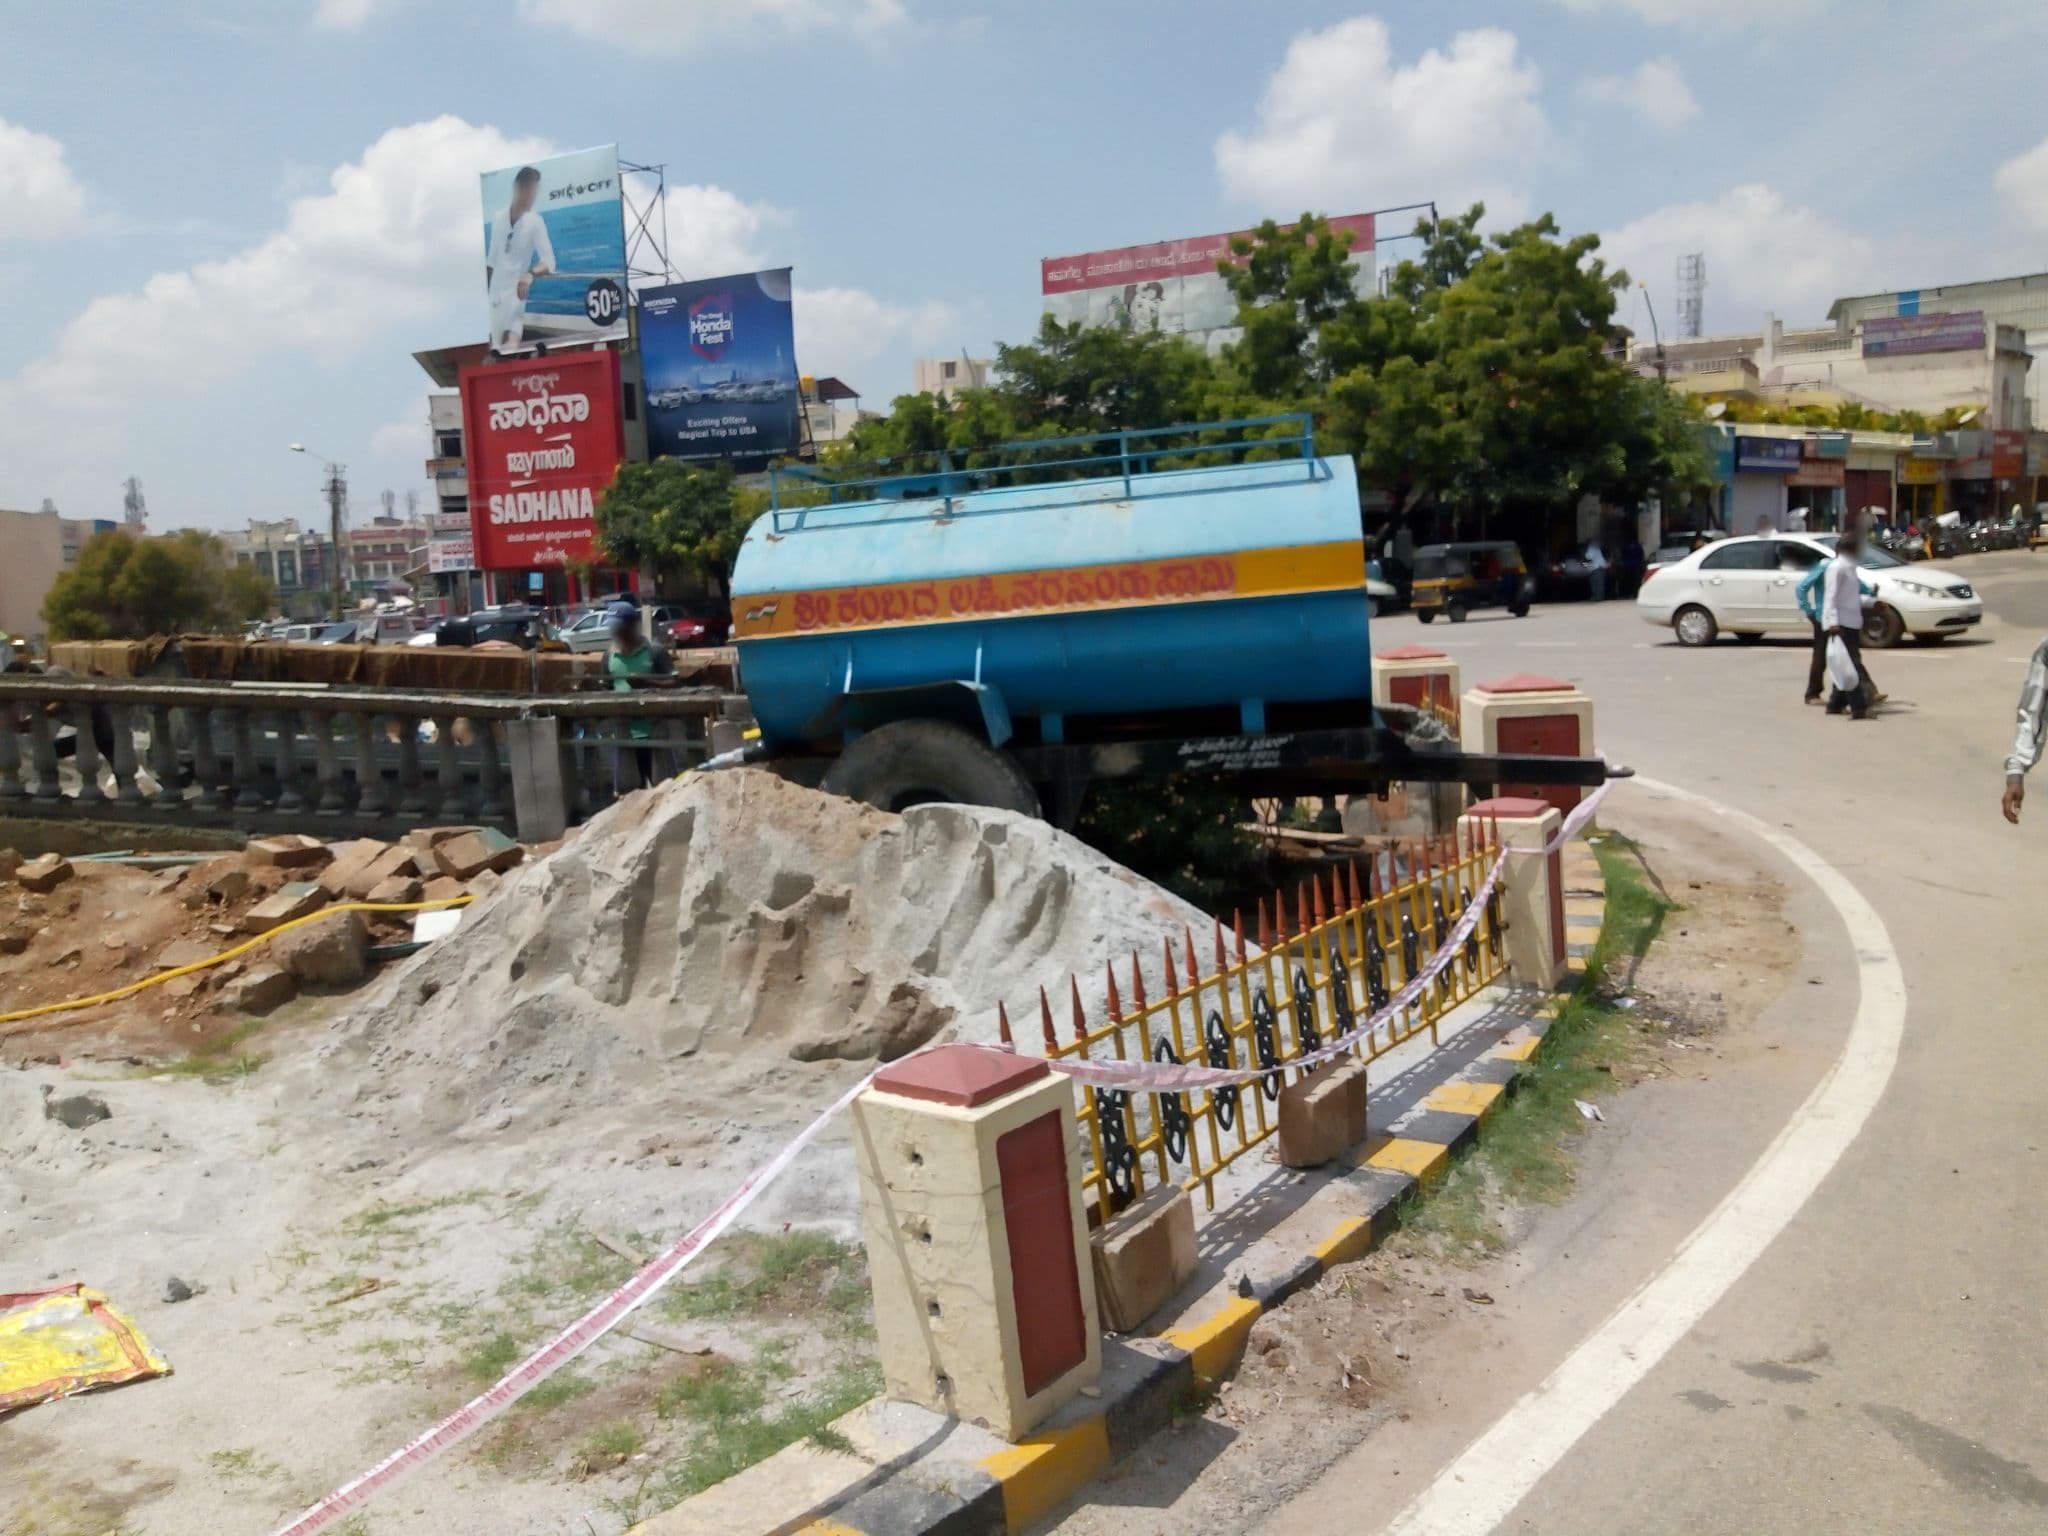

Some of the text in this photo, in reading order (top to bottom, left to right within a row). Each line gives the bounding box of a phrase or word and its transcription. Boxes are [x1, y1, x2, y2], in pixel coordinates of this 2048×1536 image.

[691, 319, 731, 334] Honda
[700, 332, 724, 345] Fest
[488, 388, 590, 435] ಸಾಧನಾ
[687, 416, 747, 428] Exciting Offers
[678, 426, 758, 440] Magical Trip to USA
[489, 487, 594, 525] SADHANA
[837, 580, 938, 624] ಕಂಬದ
